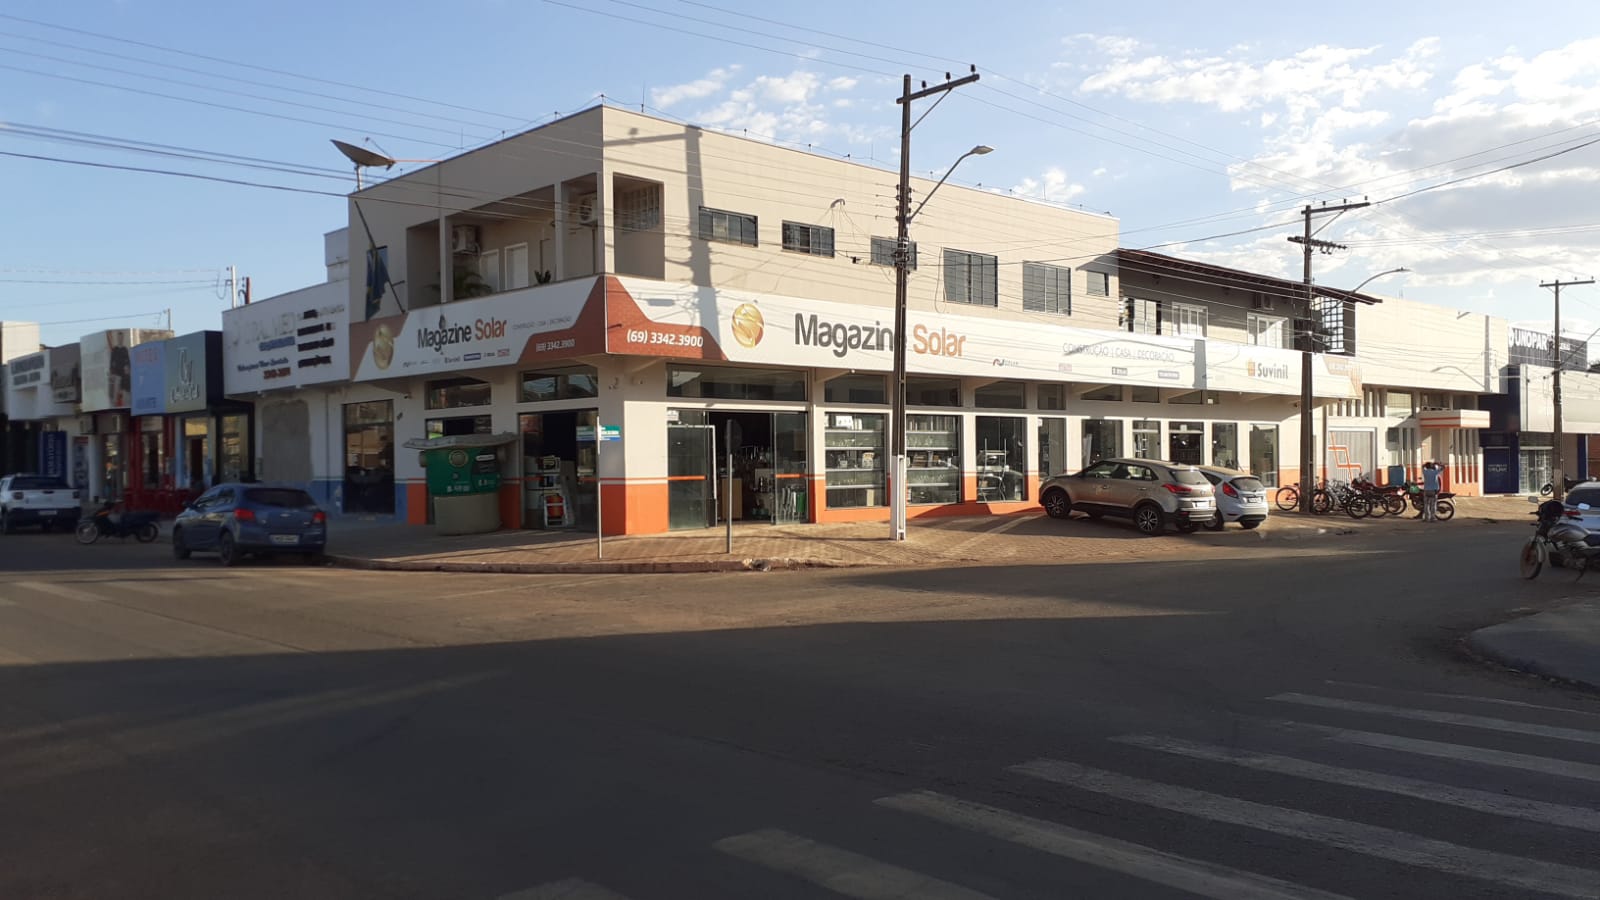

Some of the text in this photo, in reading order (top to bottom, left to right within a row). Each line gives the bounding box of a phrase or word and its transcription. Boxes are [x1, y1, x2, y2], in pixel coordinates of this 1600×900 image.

[418, 322, 472, 353] Magazine
[475, 317, 507, 341] Solar
[627, 329, 704, 347] (69) 3342.3900
[795, 313, 966, 358] Magazin Solar
[1258, 363, 1289, 379] Suvinil
